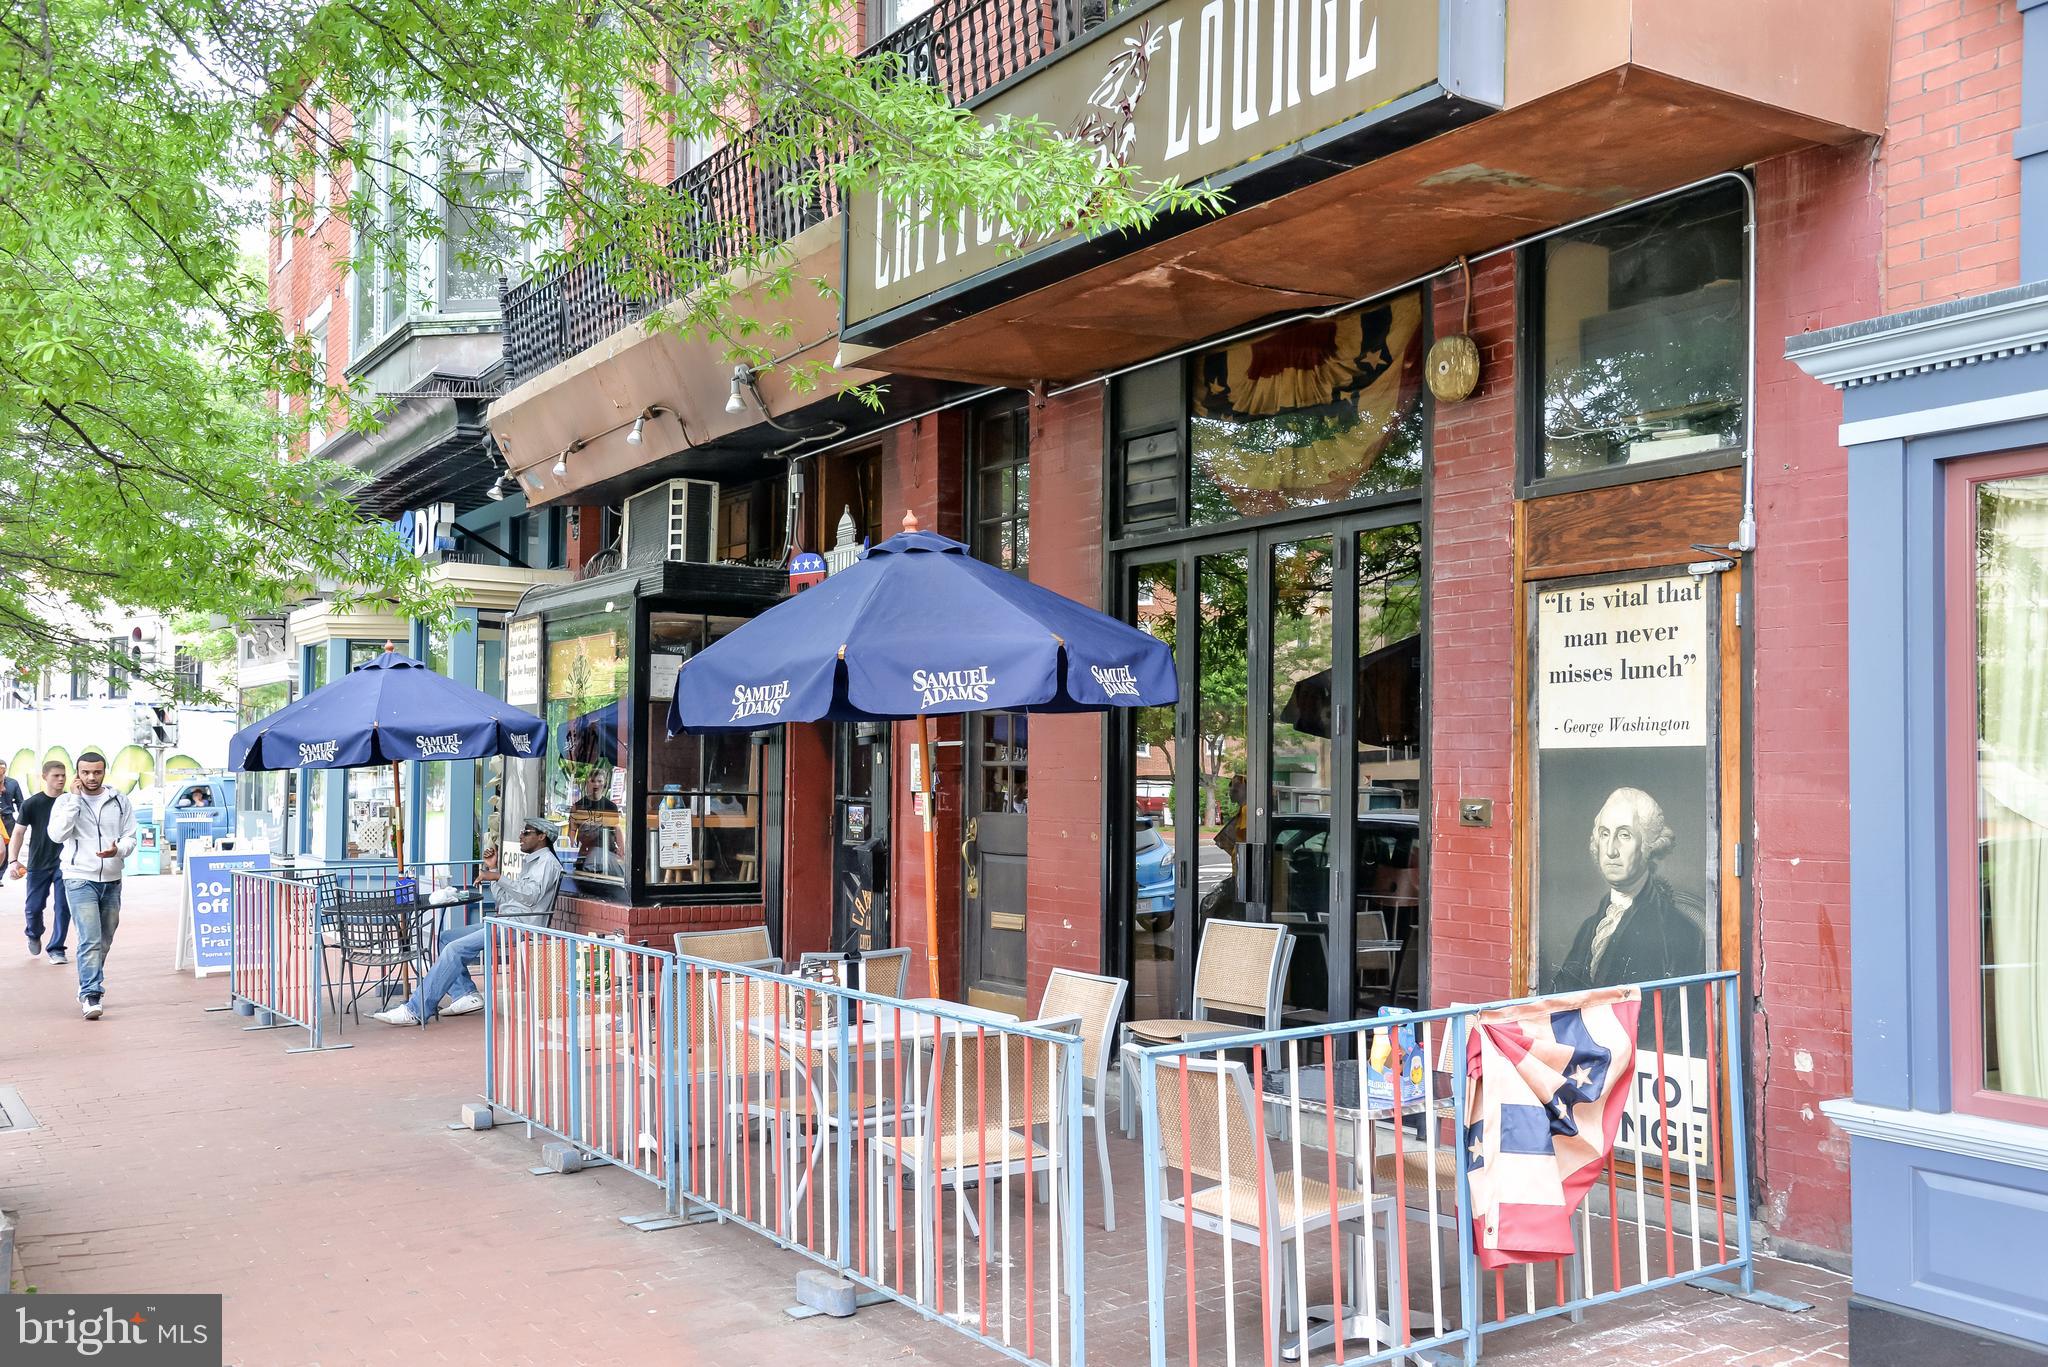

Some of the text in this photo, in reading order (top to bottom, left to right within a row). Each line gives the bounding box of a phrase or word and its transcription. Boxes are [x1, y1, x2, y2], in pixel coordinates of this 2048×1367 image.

[1164, 0, 1377, 161] LOUNGE
[1579, 591, 1595, 612] is
[1603, 583, 1649, 609] vital
[1657, 580, 1702, 604] that
[1564, 625, 1679, 648] man never
[912, 665, 996, 692] SAMUEL
[1090, 664, 1138, 685] SAMUEL
[1549, 663, 1613, 684] misses
[731, 680, 791, 706] SAMUEL
[920, 684, 989, 710] ADAMS
[1102, 682, 1141, 699] ADAMS
[728, 698, 785, 723] ADAMS
[1563, 718, 1604, 737] George
[1609, 716, 1691, 736] Washington
[298, 739, 339, 757] SAMUEL
[415, 733, 463, 749] SAMUEL
[510, 732, 531, 745] SAMUEL
[298, 750, 335, 766] ADAMS
[421, 744, 460, 758] ADAMS
[197, 897, 229, 914] off
